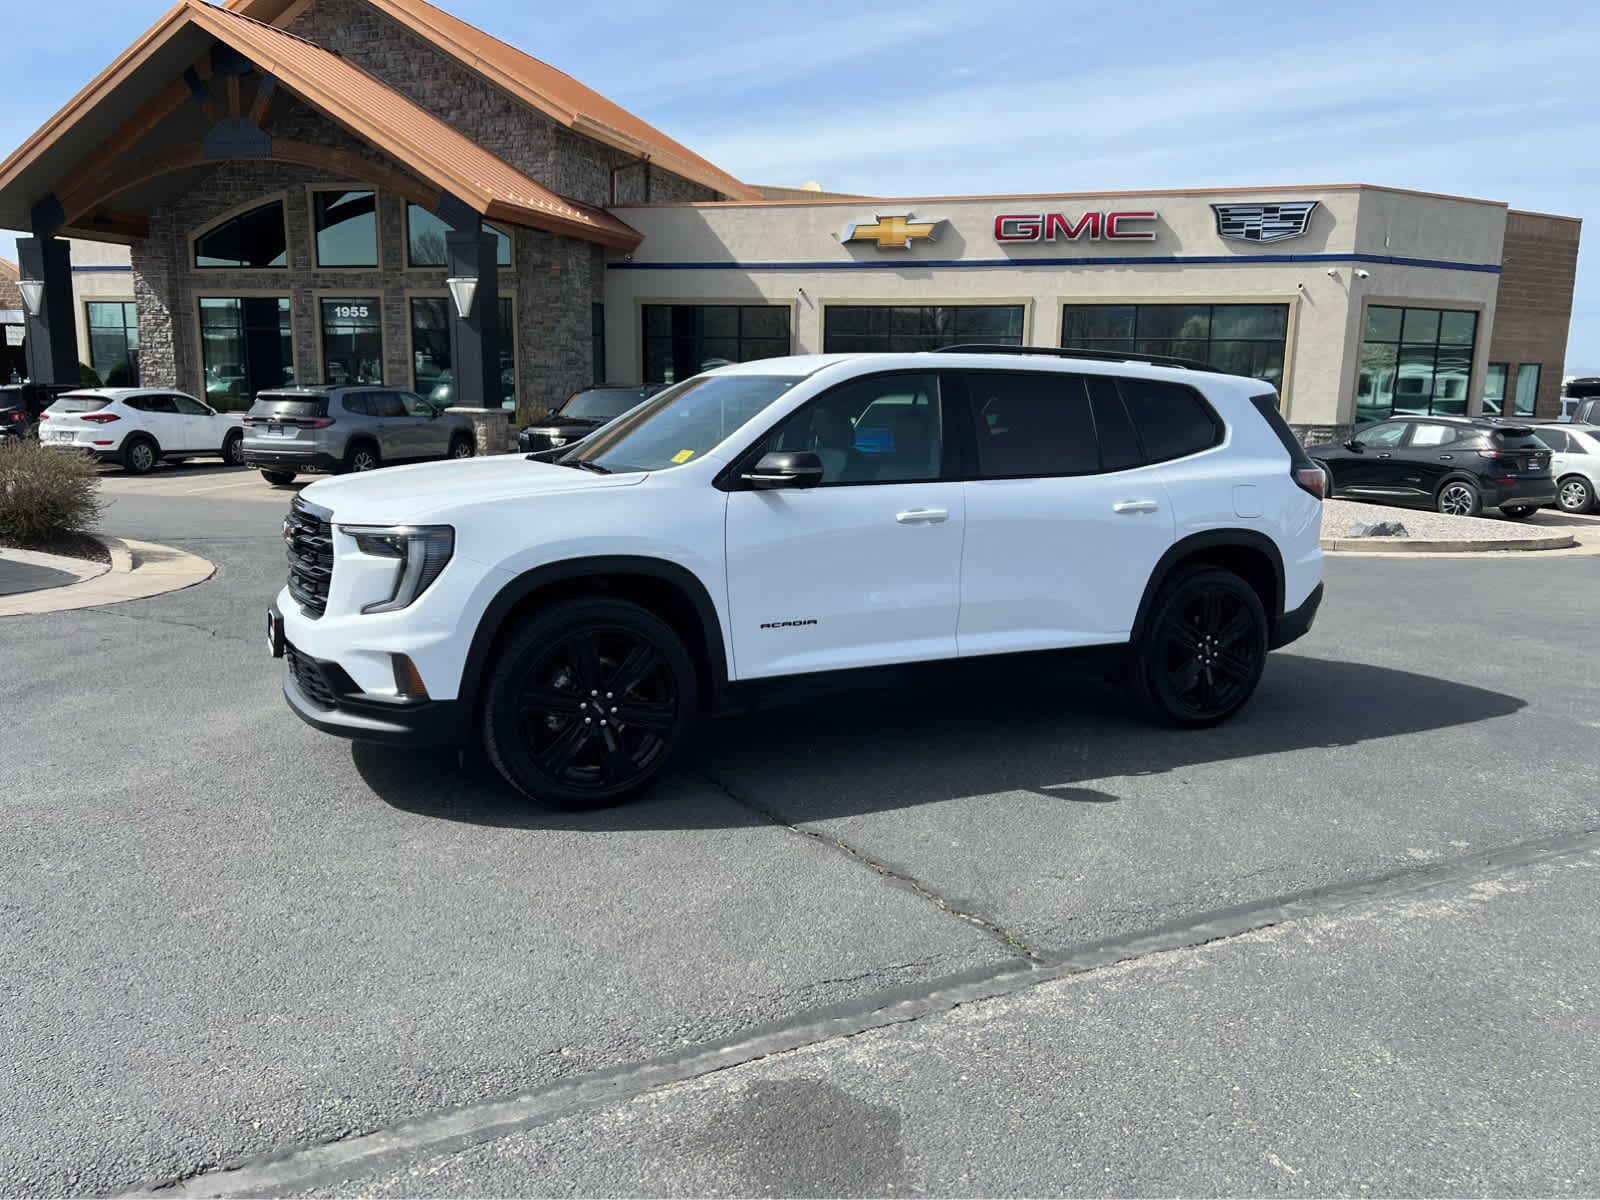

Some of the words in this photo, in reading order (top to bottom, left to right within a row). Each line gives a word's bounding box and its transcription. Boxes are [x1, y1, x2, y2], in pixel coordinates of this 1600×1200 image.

[994, 211, 1158, 242] GMC
[334, 306, 369, 318] 1955
[760, 619, 818, 629] ACADIA
